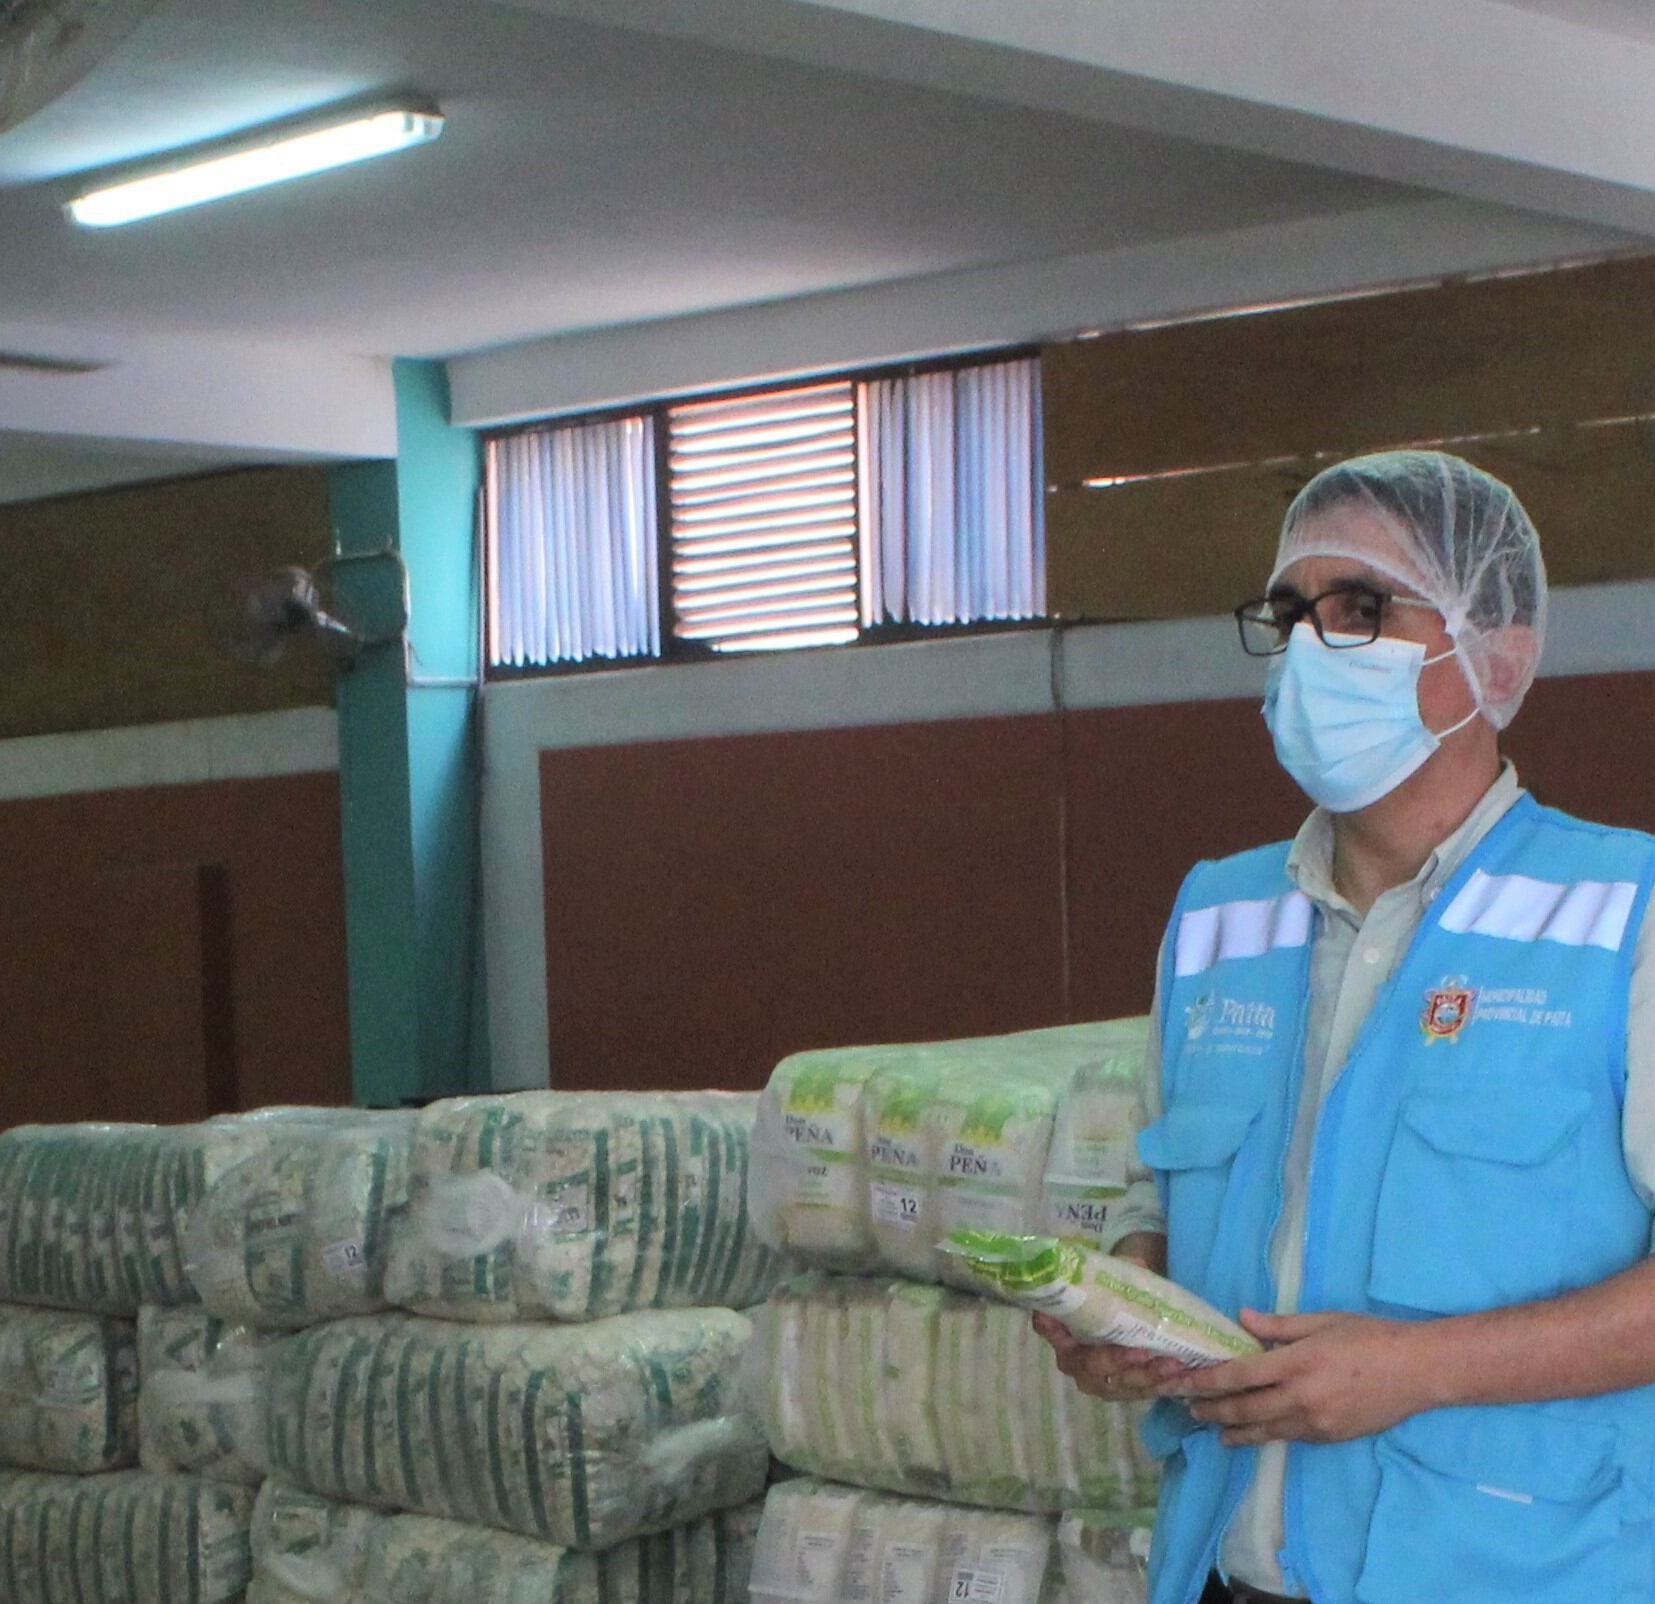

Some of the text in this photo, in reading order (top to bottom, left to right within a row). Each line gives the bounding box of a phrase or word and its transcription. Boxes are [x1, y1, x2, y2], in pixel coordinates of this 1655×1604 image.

[949, 1153, 996, 1176] PEÑ
[900, 1197, 919, 1215] 12
[345, 1244, 357, 1260] 12
[955, 1580, 970, 1599] 12
